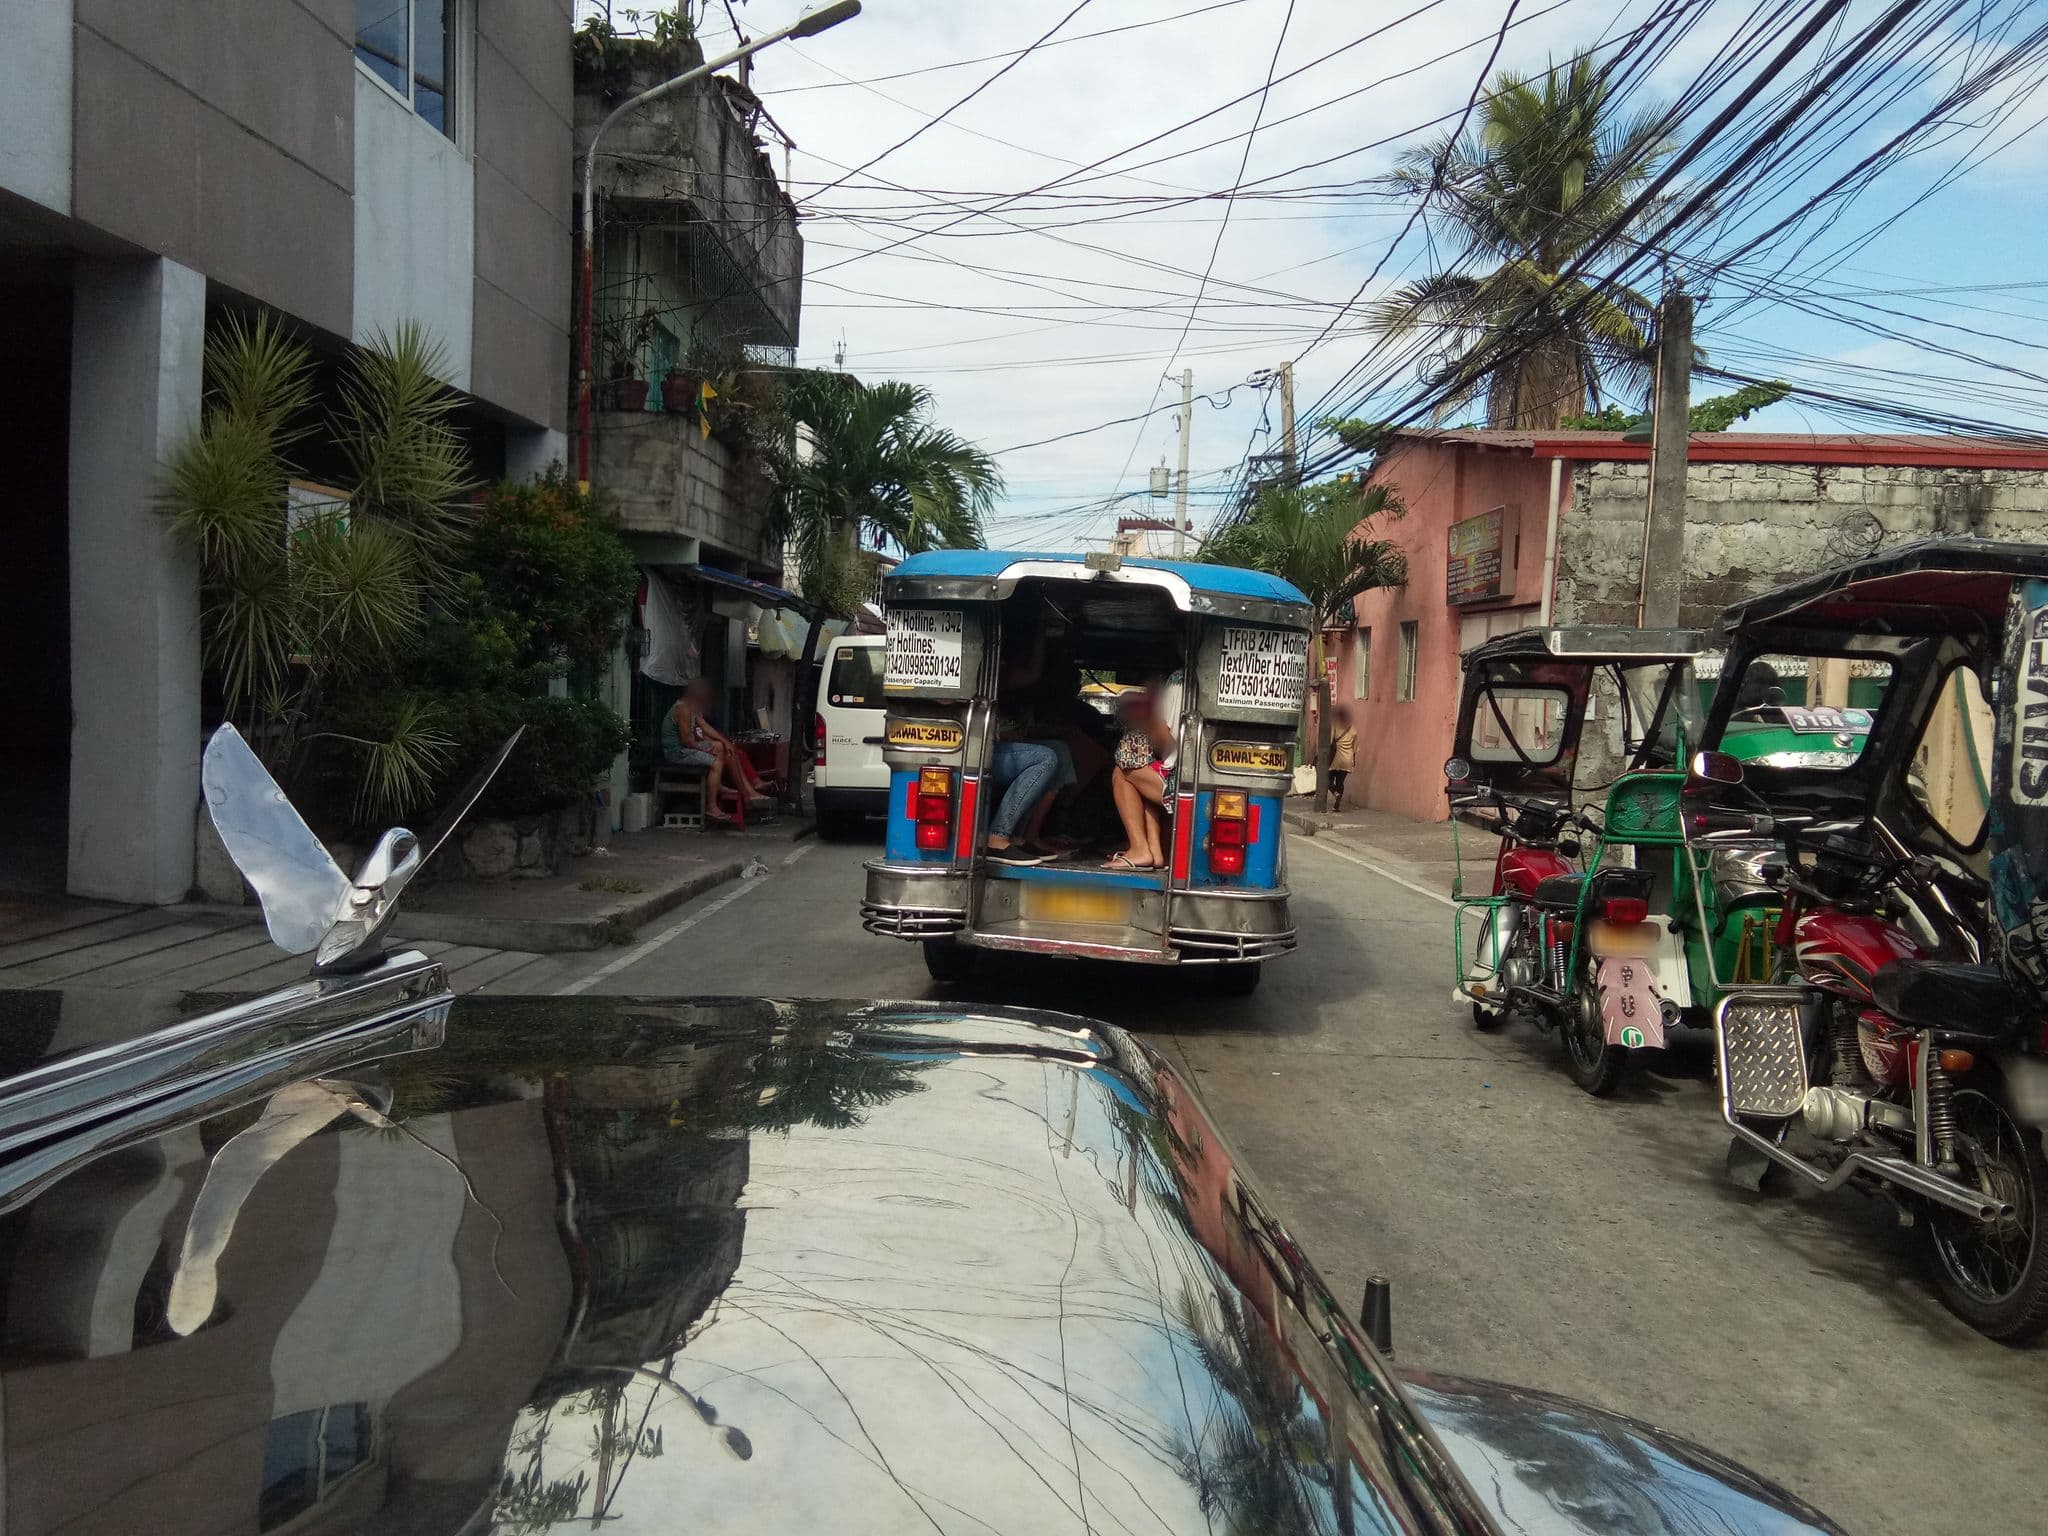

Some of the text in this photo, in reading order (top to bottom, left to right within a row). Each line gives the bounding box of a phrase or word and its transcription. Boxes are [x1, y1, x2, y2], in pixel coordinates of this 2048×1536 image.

[897, 632, 936, 654] Hotlines:
[1222, 629, 1256, 651] LTFRB
[1258, 631, 1280, 653] 24/7
[1221, 651, 1272, 675] Text/Viber
[914, 677, 942, 686] Capacity
[1218, 697, 1253, 705] Maximum
[1254, 699, 1290, 709] Passenger
[1793, 714, 1845, 727] 3154
[925, 728, 959, 742] SABIT
[1216, 749, 1255, 764] BAWAL
